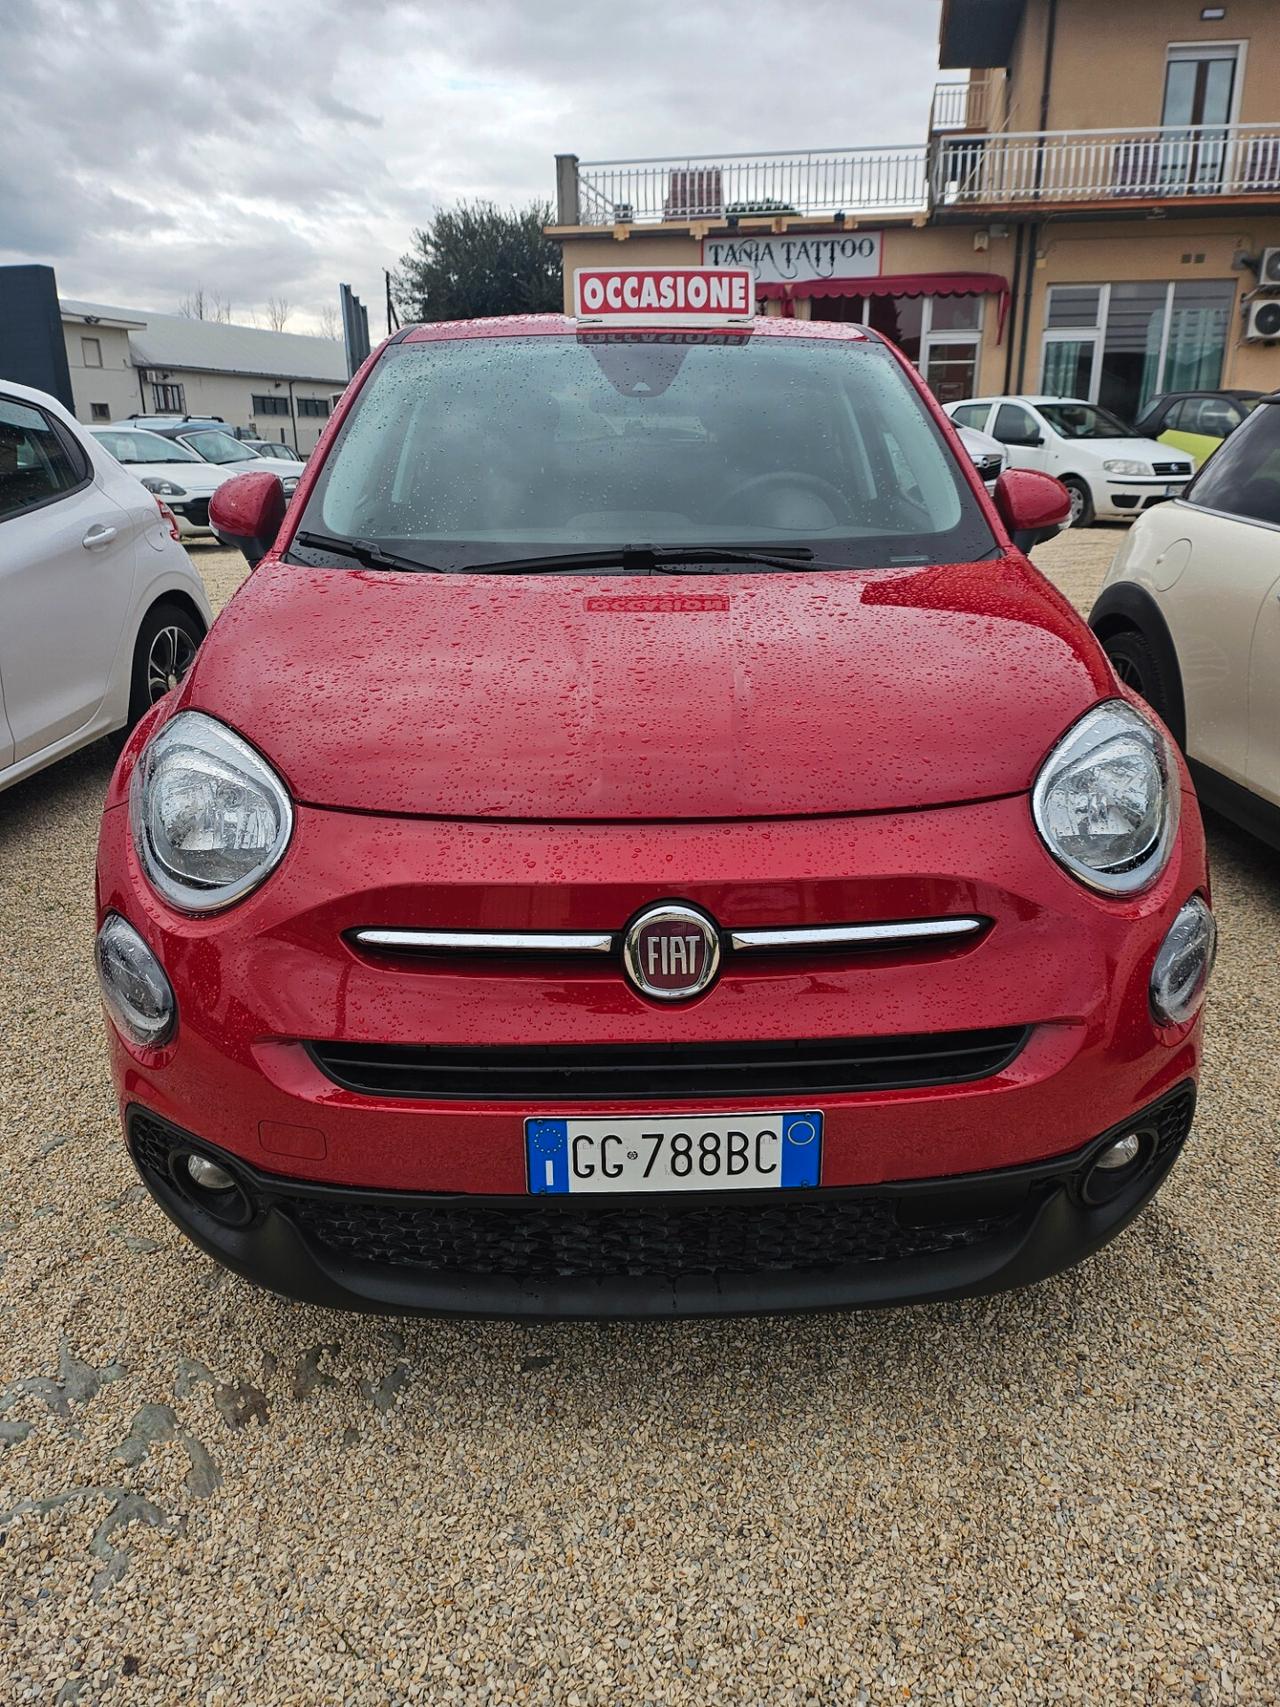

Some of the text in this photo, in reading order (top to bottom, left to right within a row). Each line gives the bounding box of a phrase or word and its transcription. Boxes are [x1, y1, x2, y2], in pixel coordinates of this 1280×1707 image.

[709, 238, 875, 279] TANIA TATTOO
[583, 276, 746, 309] OCCASIONE
[647, 936, 700, 975] FIAT
